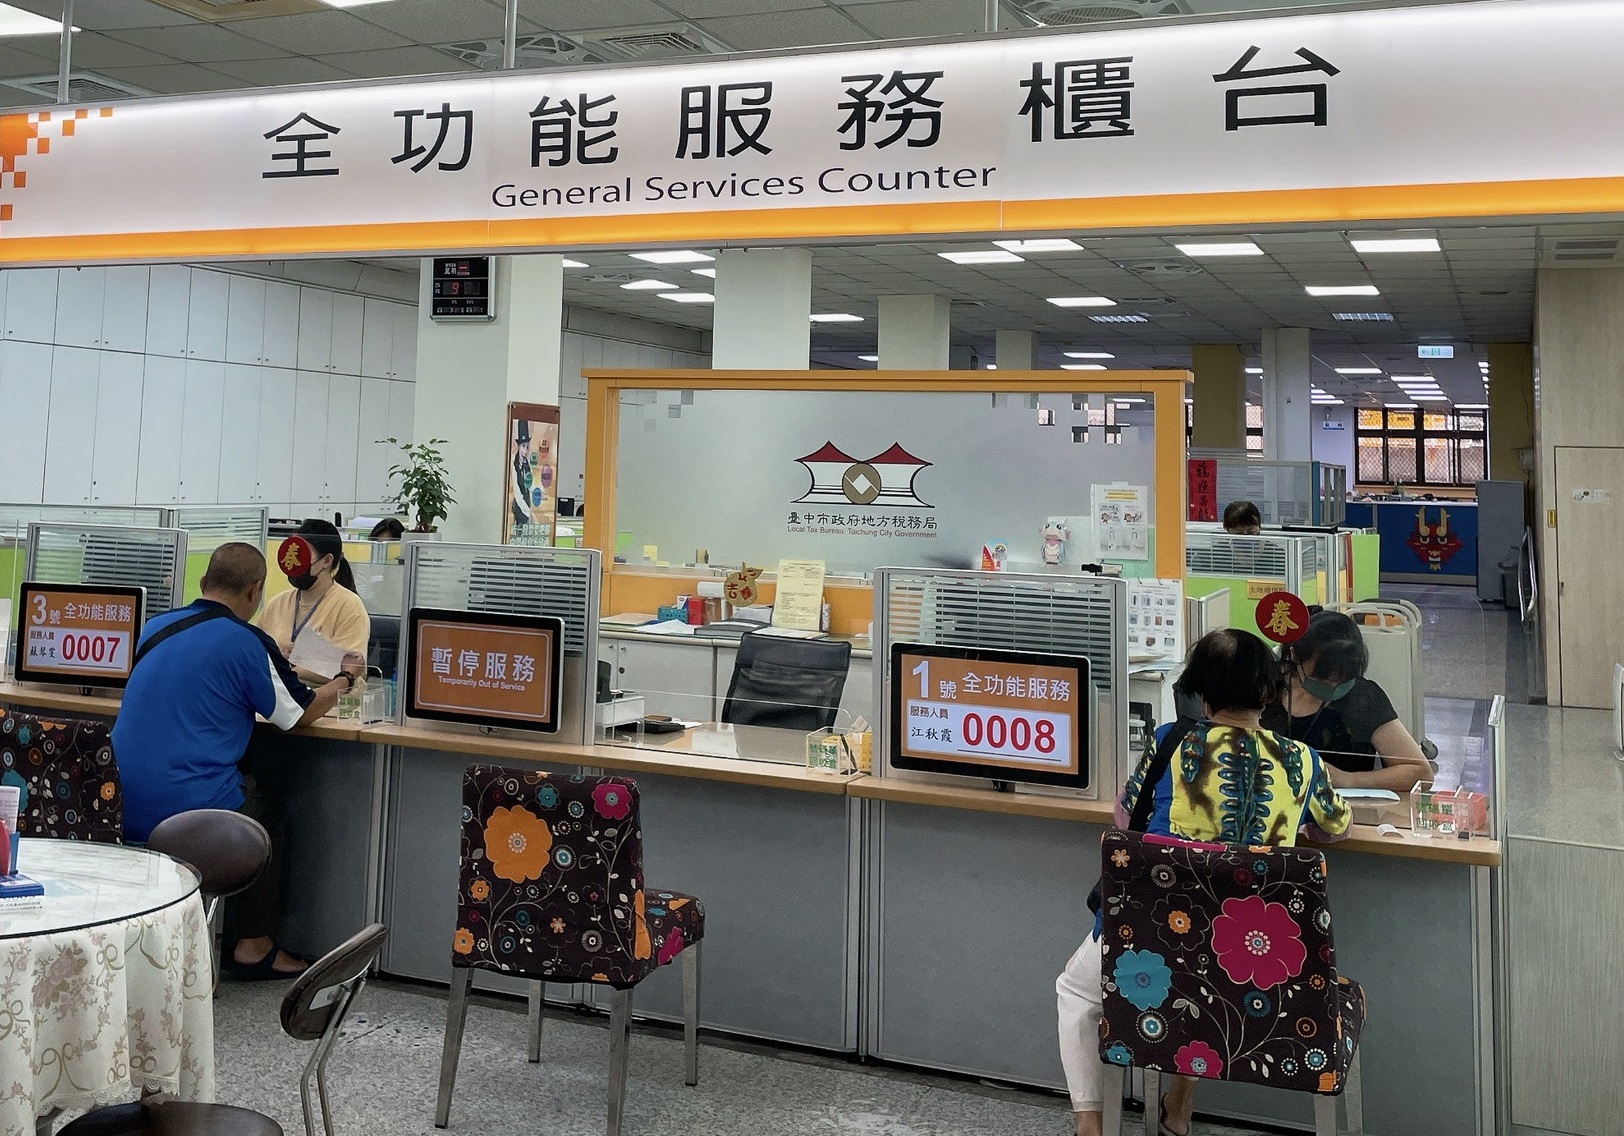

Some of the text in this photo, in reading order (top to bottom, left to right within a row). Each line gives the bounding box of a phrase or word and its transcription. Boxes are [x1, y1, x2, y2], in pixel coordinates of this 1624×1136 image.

[262, 44, 1341, 180] 全功能服務櫃台
[491, 164, 997, 208] General Services Counter
[787, 511, 938, 530] 臺中市政府地方稅務局
[806, 526, 818, 534] Tax
[848, 528, 877, 538] Taichung
[880, 529, 893, 538] City
[894, 530, 938, 539] Government
[280, 542, 301, 571] 春
[64, 602, 132, 623] 全功能服務
[1264, 599, 1299, 636] 春
[30, 630, 55, 640] 服務人員
[62, 633, 121, 663] 0007
[431, 647, 536, 683] 暫停服務
[438, 675, 526, 692] Temporarily Out of Service
[961, 671, 1071, 702] 全功能服務
[910, 705, 949, 719] 服務人員
[911, 726, 953, 743] 江秋霞
[962, 712, 1056, 754] 0008
